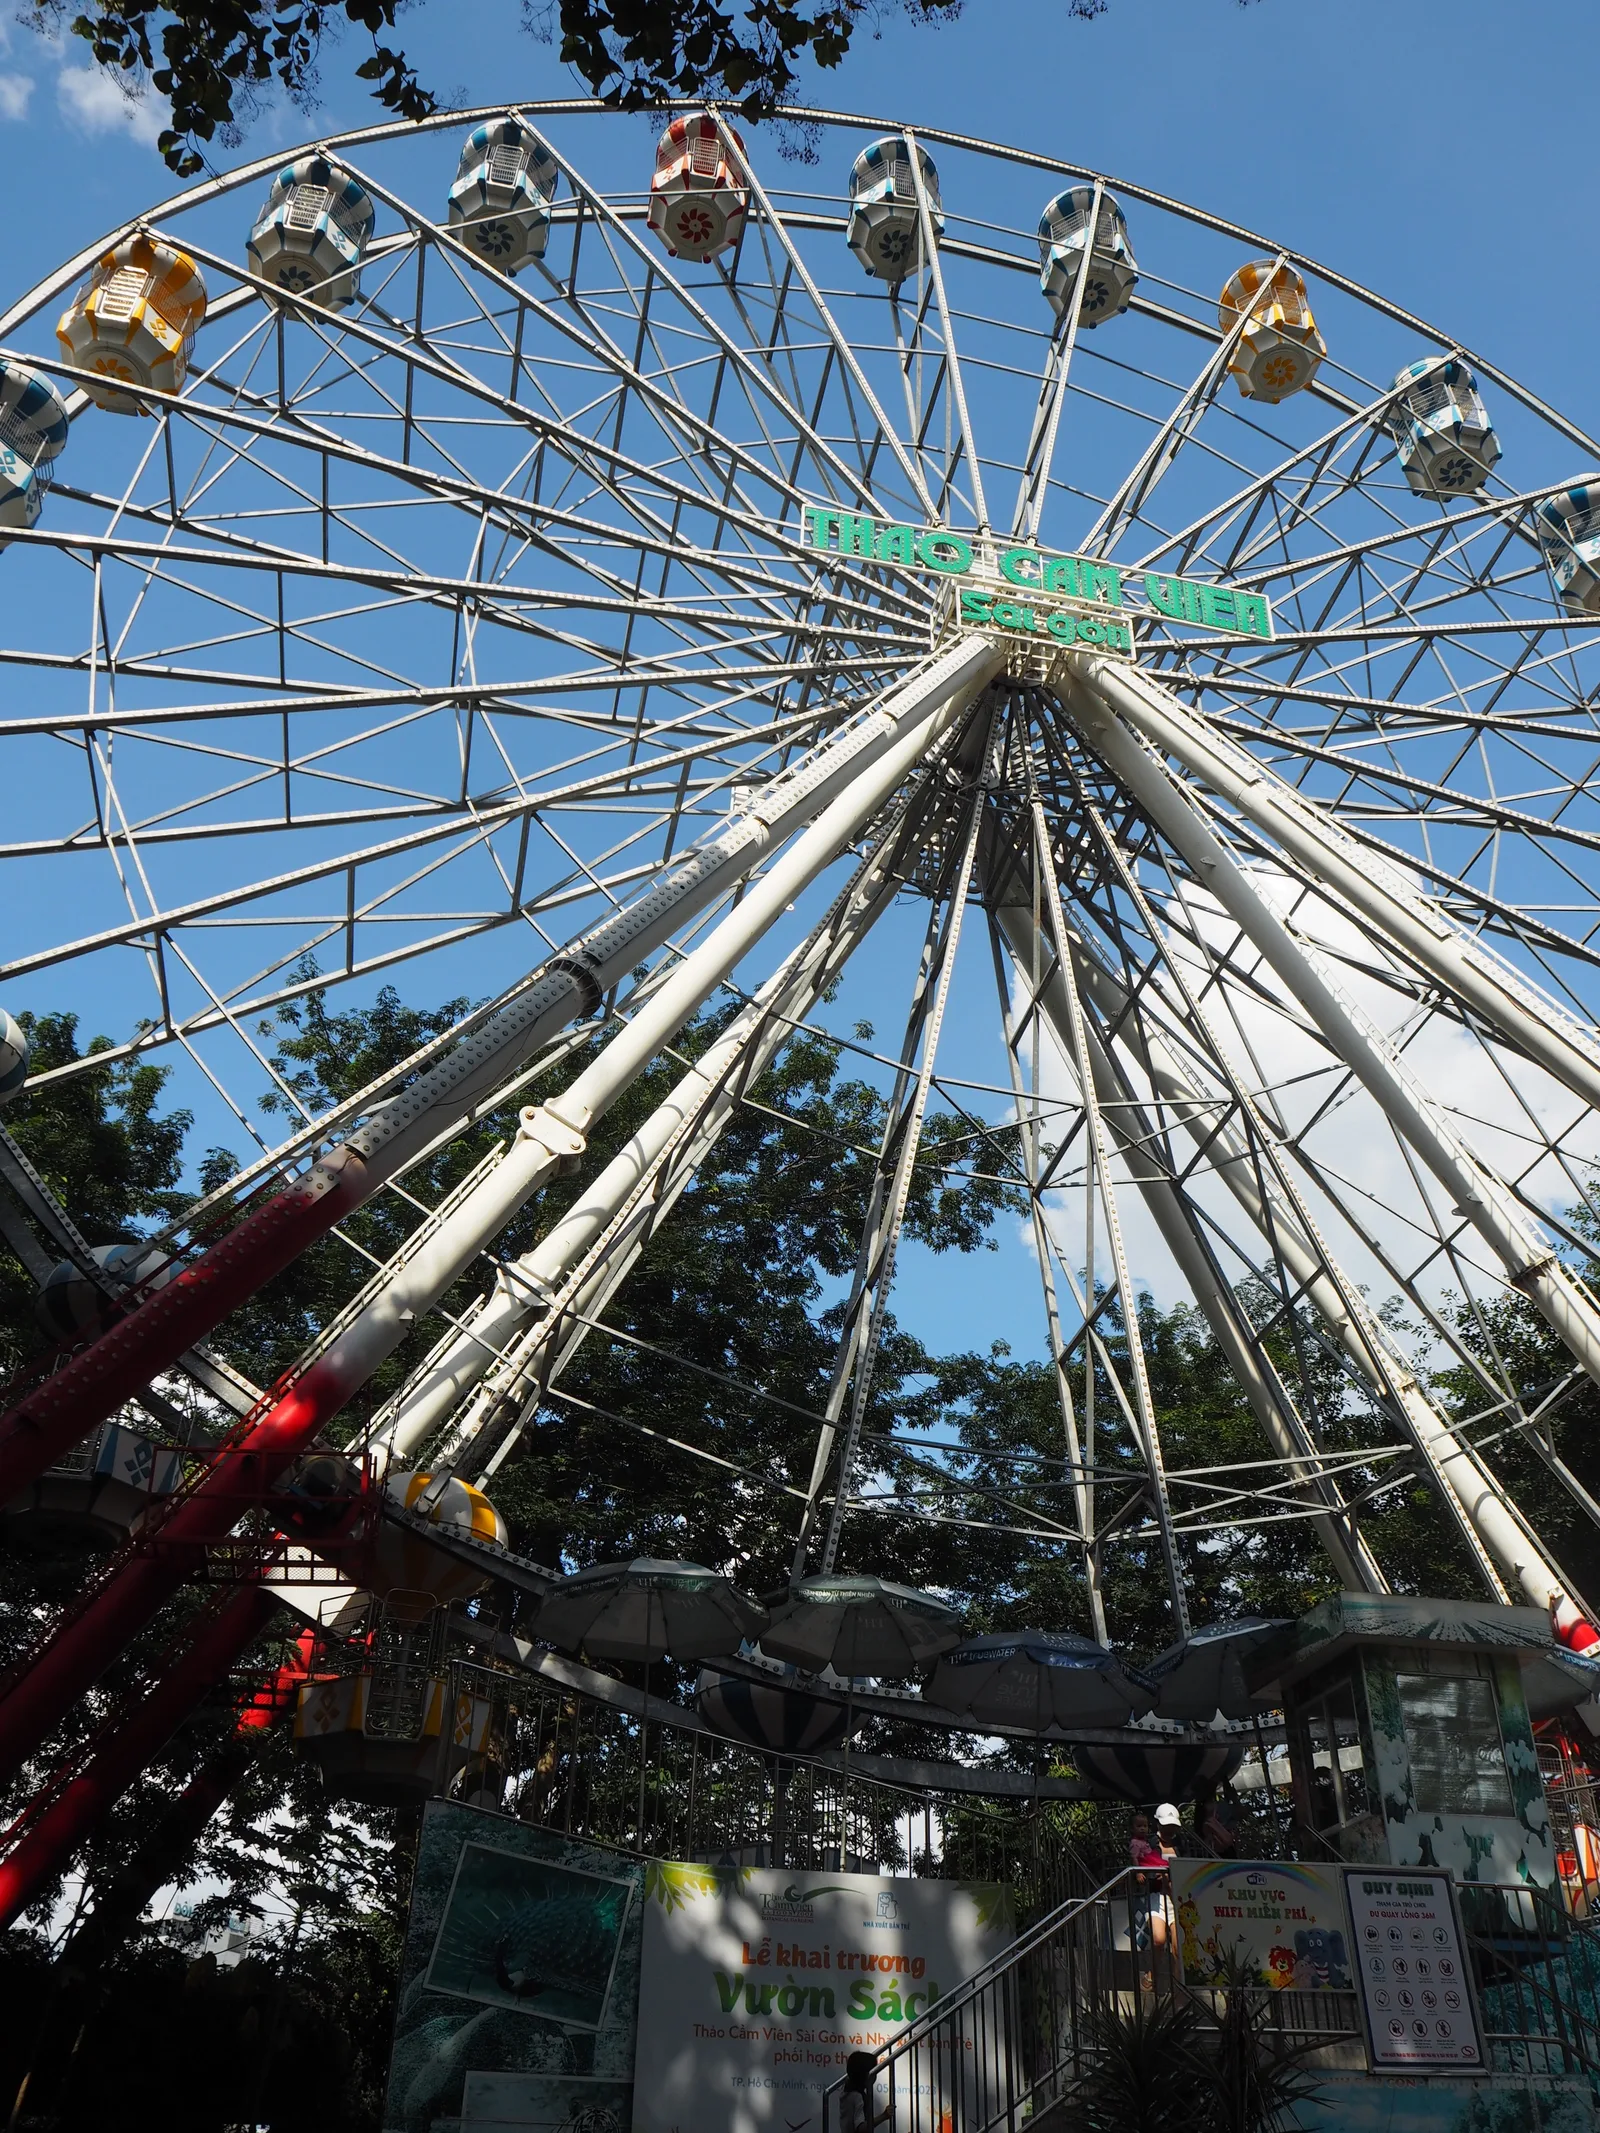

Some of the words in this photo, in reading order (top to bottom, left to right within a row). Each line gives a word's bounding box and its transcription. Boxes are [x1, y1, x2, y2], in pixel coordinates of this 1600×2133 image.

[805, 506, 973, 574] THAO
[999, 547, 1121, 606] CAM
[1227, 1888, 1256, 1901] KHU
[1260, 1889, 1286, 1904] VỰC
[1362, 1881, 1392, 1896] QUY
[1396, 1882, 1434, 1899] ĐỊNH
[1213, 1906, 1243, 1918] WIFI
[1246, 1902, 1281, 1920] MIỄN
[1284, 1906, 1307, 1920] PHÍ
[1381, 1910, 1399, 1919] QUAY
[742, 1936, 771, 1967] Lễ
[776, 1943, 831, 1969] khai
[836, 1949, 926, 1980] trương
[713, 1971, 836, 2019] Vườn
[693, 2023, 725, 2039] Thảo
[729, 2024, 759, 2040] Cầm
[763, 2027, 793, 2042] Viên
[796, 2028, 815, 2043] Sài
[818, 2029, 846, 2044] Gòn
[849, 2032, 863, 2046] và
[774, 2046, 802, 2065] phối
[806, 2050, 832, 2067] hợp
